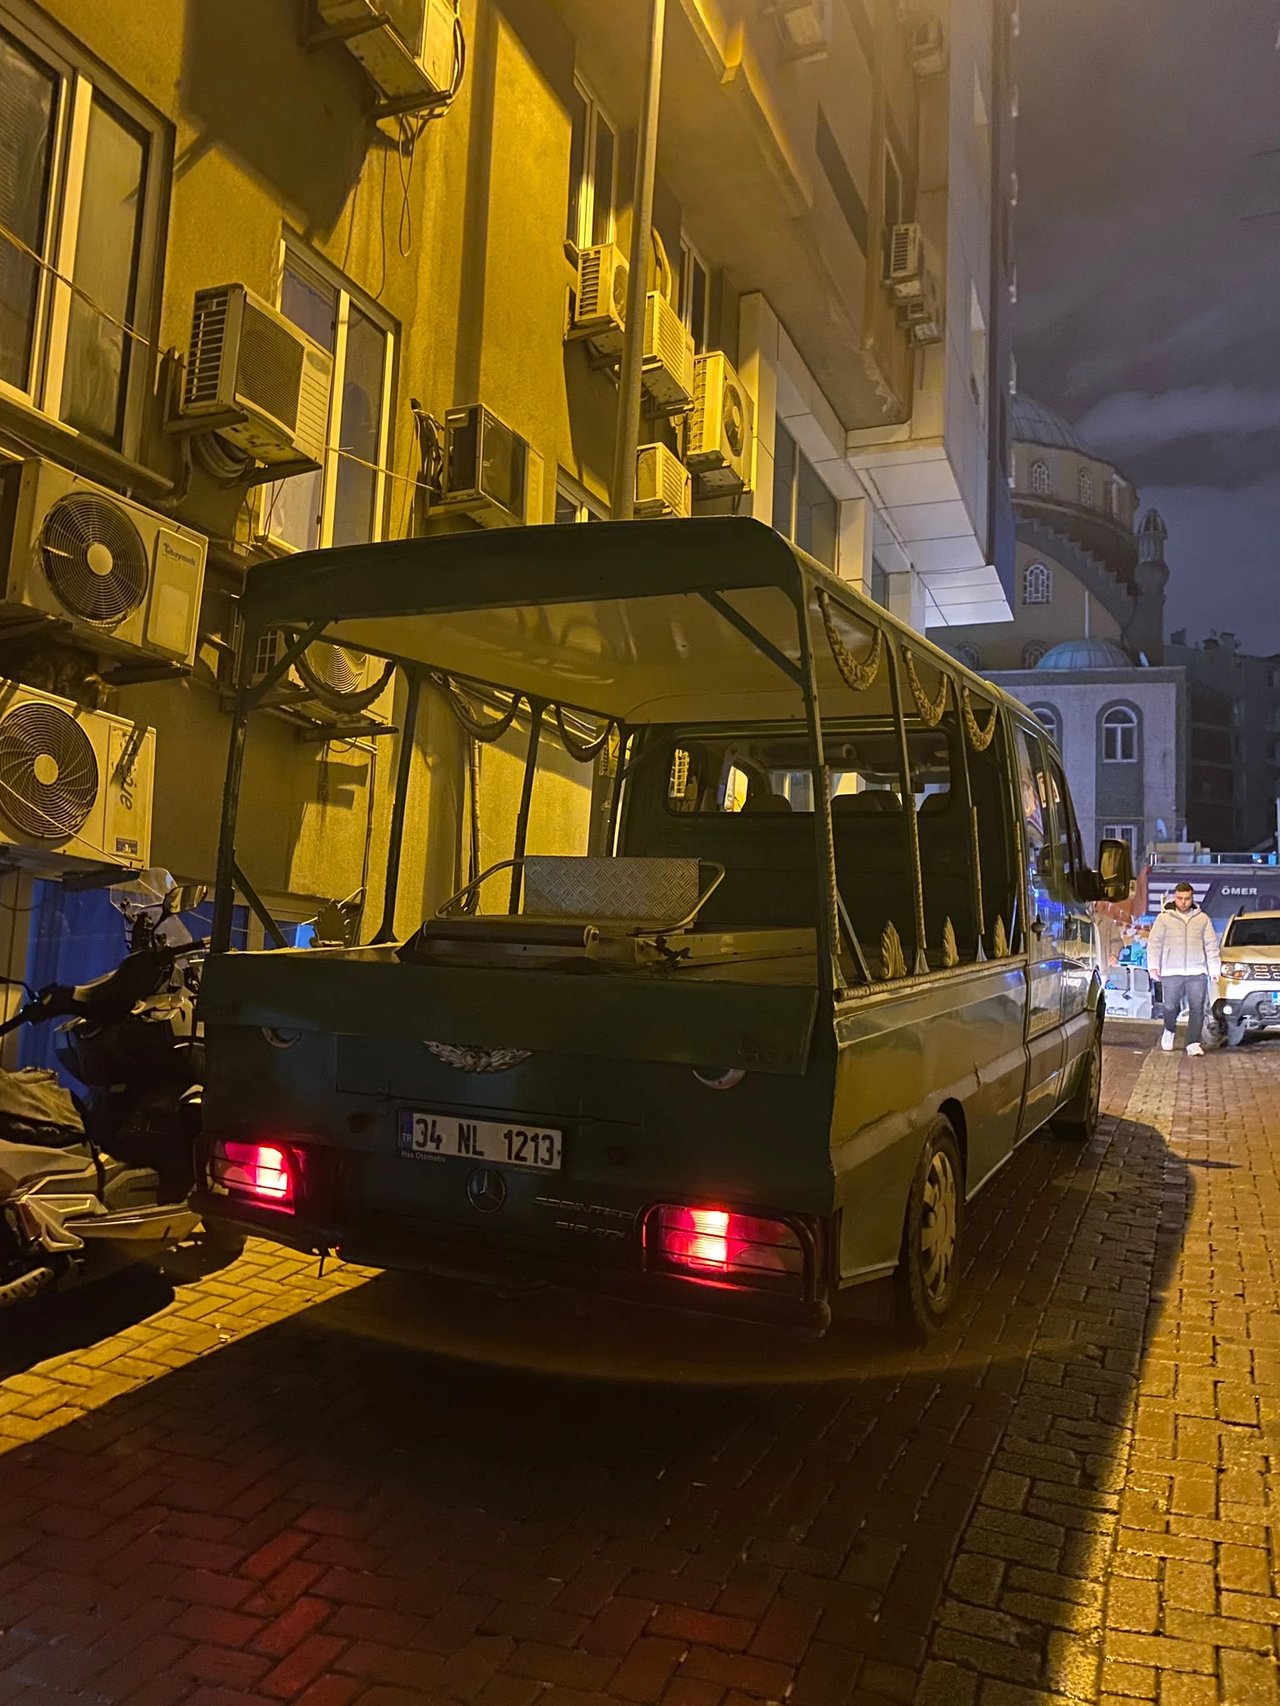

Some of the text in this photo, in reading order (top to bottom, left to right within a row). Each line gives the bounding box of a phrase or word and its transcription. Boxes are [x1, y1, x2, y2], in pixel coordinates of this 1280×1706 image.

[1221, 886, 1257, 895] ÖMER
[402, 1133, 412, 1142] TR
[415, 1118, 554, 1165] 34 NL 1213
